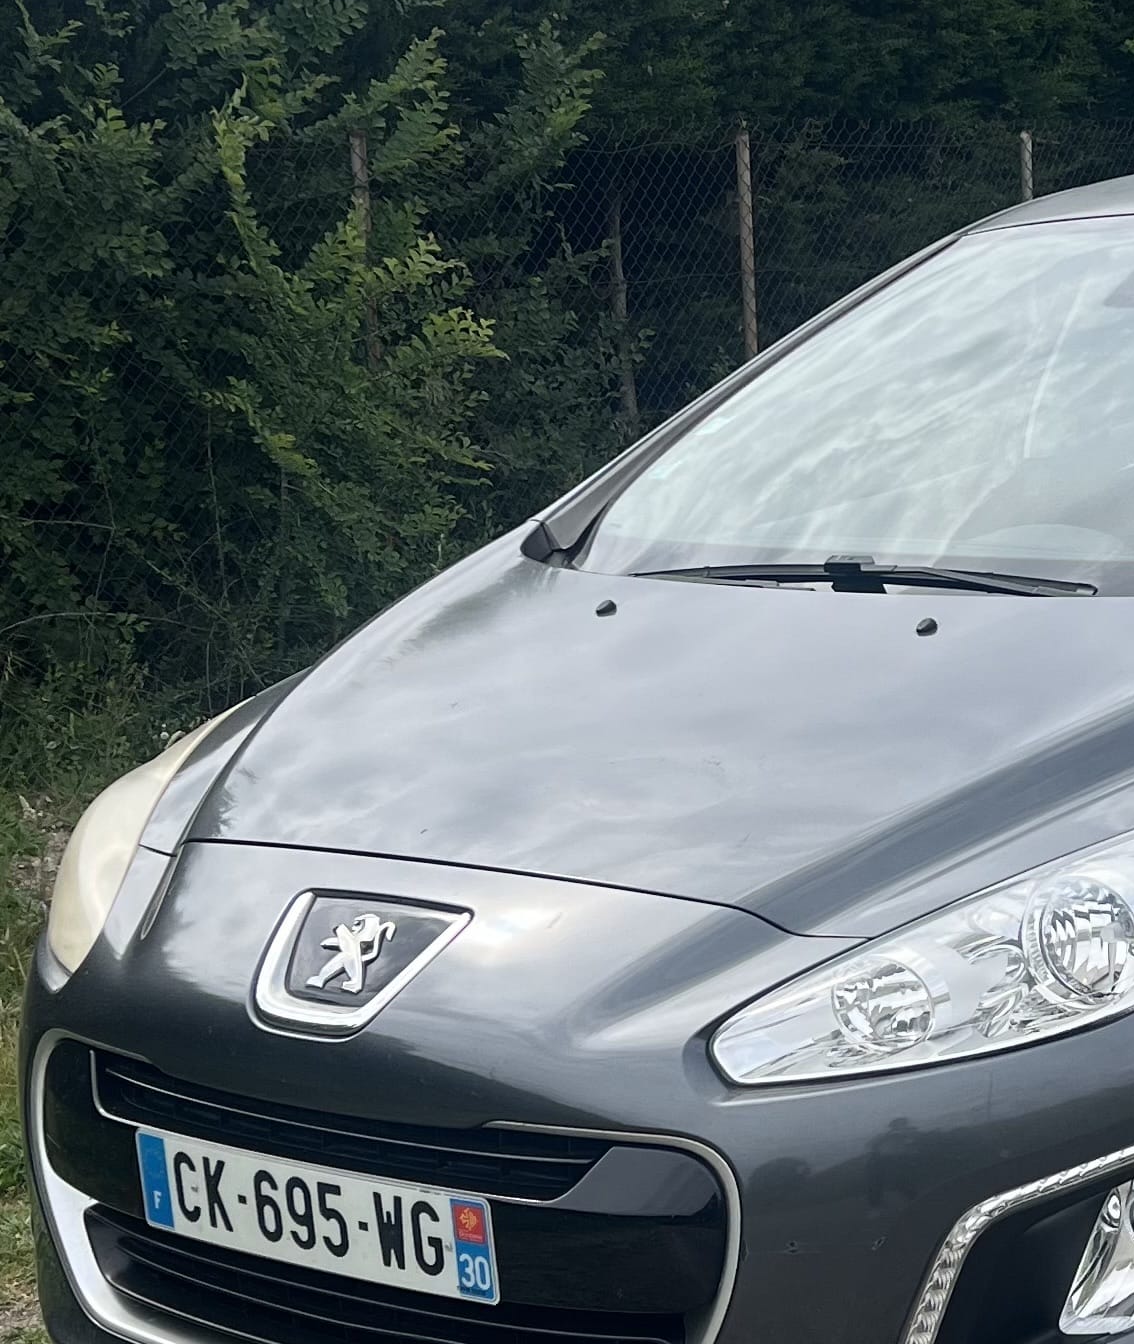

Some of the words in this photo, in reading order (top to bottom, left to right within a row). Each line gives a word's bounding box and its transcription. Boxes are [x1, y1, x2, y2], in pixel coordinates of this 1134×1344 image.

[152, 1190, 163, 1210] F
[173, 1151, 445, 1276] CK-695-WG
[459, 1253, 491, 1291] 30
